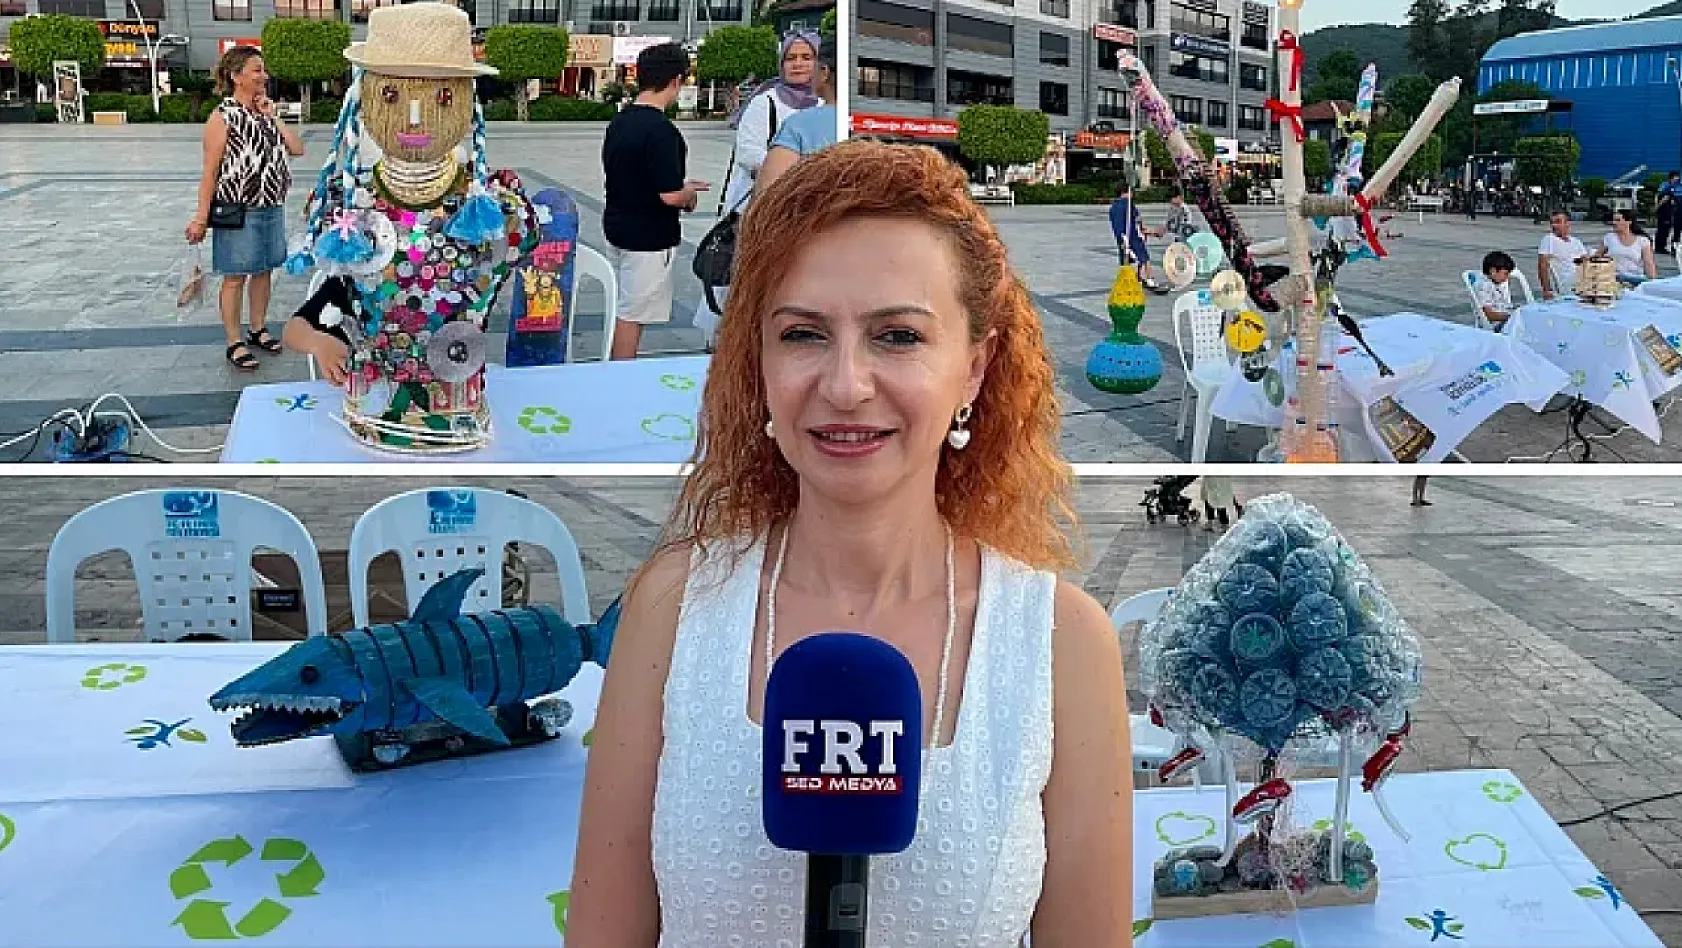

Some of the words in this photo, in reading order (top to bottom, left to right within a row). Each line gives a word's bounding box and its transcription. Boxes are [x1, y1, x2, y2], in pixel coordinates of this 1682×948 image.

[781, 719, 903, 774] FRT
[785, 777, 822, 789] SED
[828, 777, 897, 791] MEDYA
